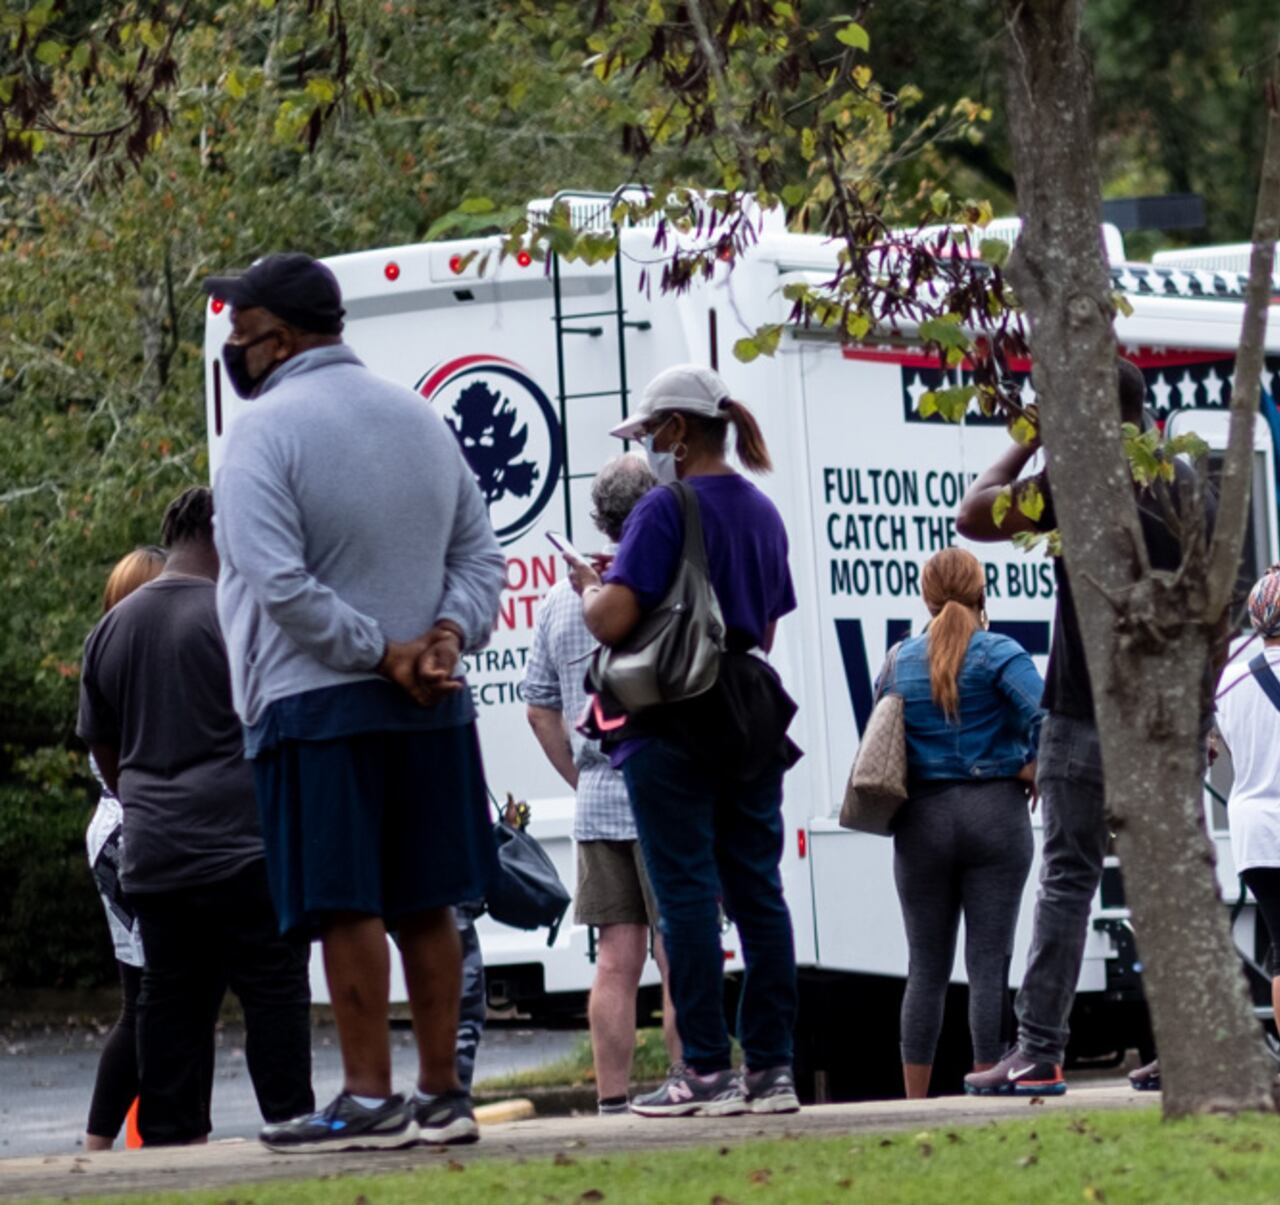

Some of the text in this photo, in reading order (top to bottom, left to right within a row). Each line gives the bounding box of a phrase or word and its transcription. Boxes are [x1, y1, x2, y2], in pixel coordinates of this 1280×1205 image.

[823, 467, 919, 506] FULTON
[827, 512, 957, 551] CATCH THE
[830, 558, 921, 596] MOTOR
